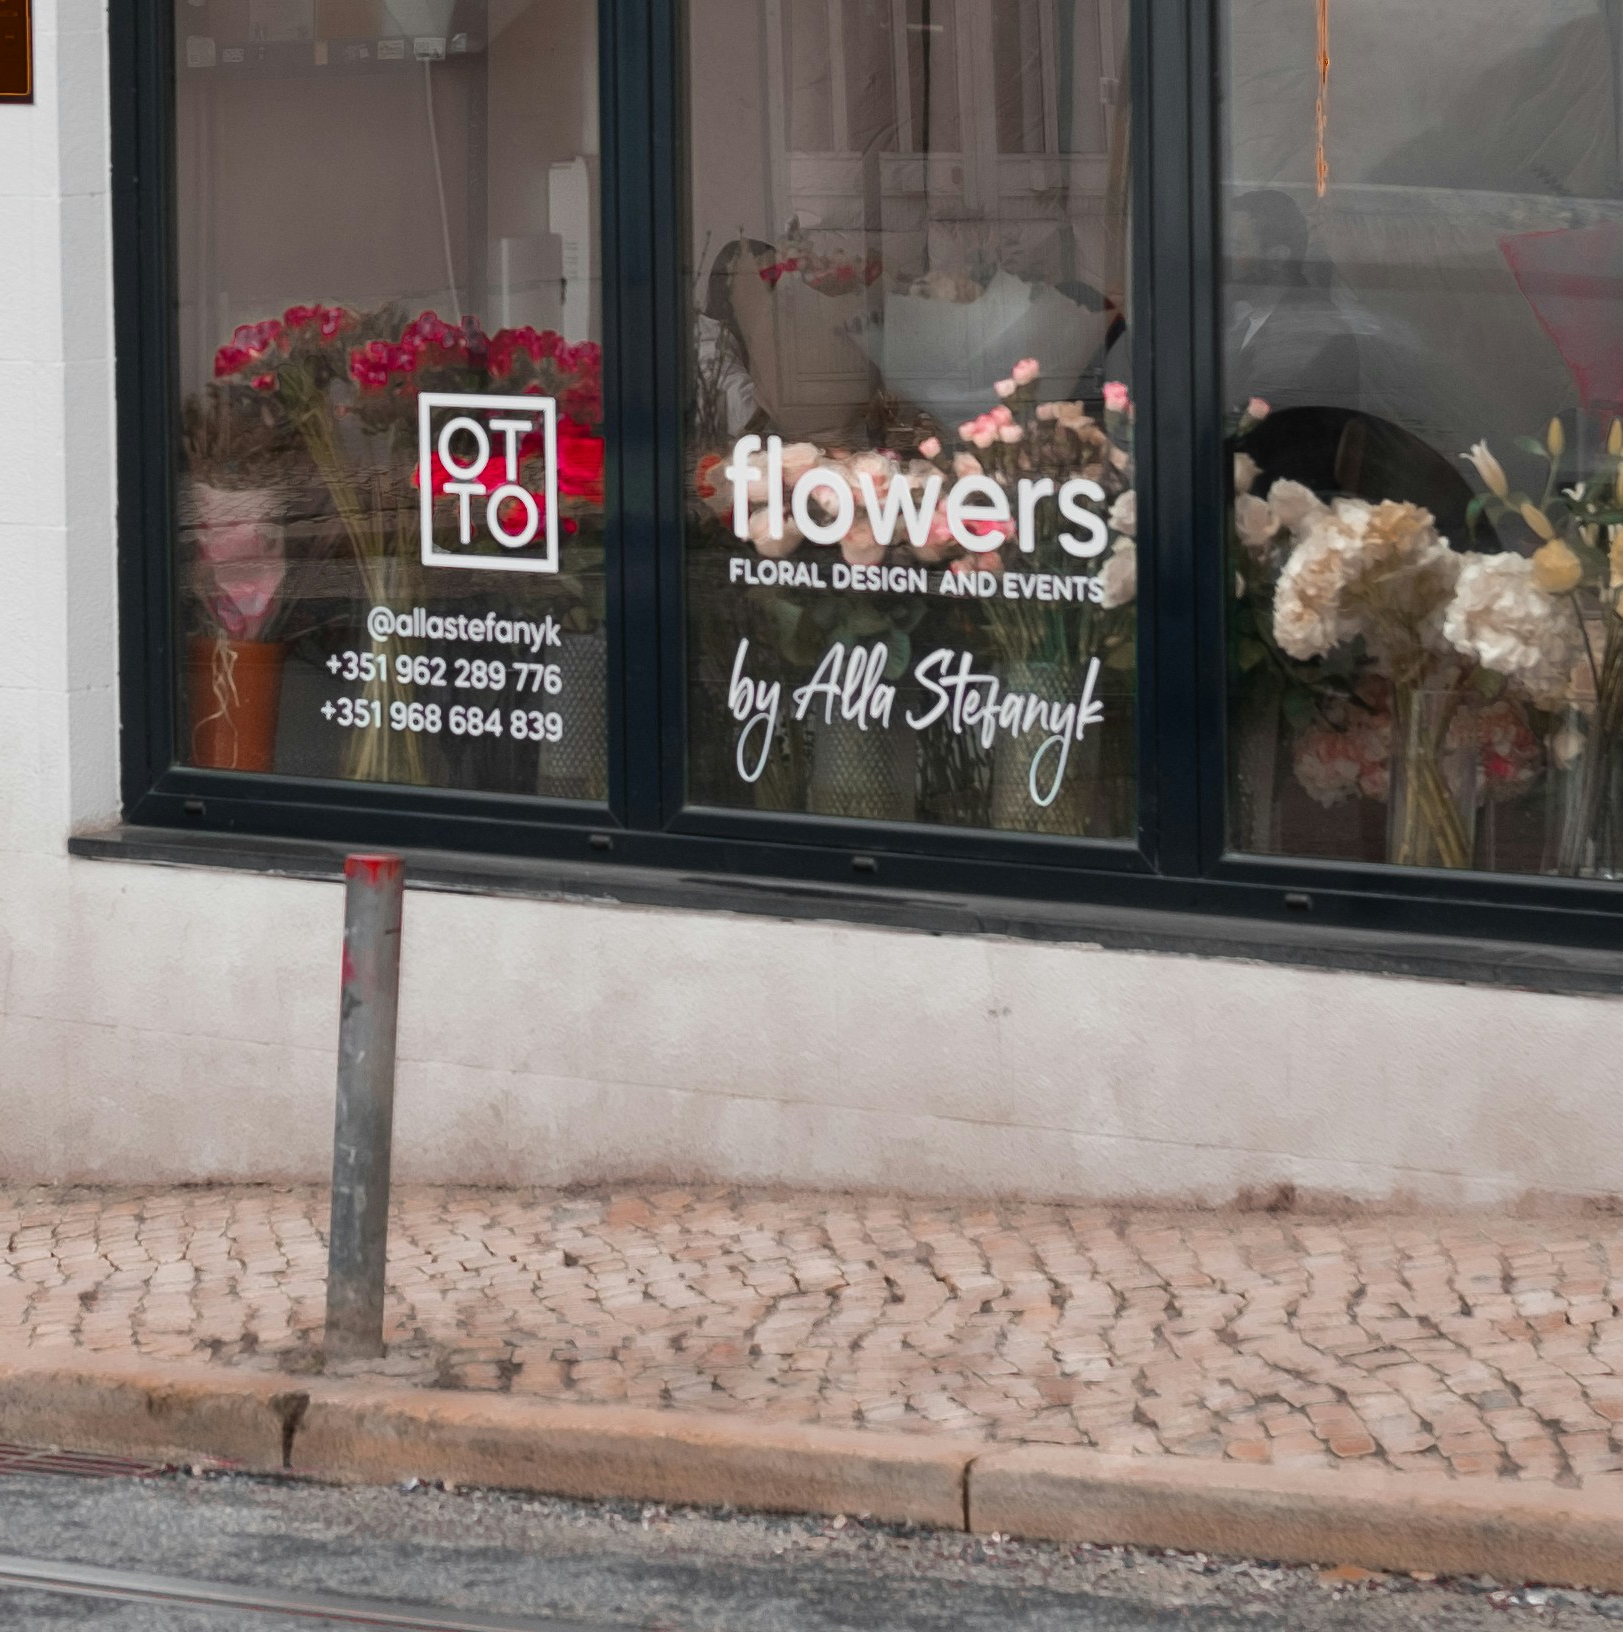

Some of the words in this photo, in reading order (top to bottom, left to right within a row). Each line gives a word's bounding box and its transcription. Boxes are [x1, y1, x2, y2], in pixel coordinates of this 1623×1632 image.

[725, 434, 1109, 558] flowers
[728, 557, 827, 589] FLORAL
[832, 565, 928, 594] DESIGN
[939, 570, 997, 598] AND
[1002, 572, 1105, 604] EVENTS
[367, 605, 562, 654] @allastefanyk
[325, 650, 387, 683] +351
[395, 654, 447, 686] 962
[454, 657, 506, 691] 289
[512, 661, 563, 695] 776
[320, 696, 382, 729] +351
[389, 700, 442, 734] 968
[448, 704, 503, 738] 684
[510, 709, 564, 743] 839
[727, 636, 781, 783] by
[792, 641, 896, 731] Alla
[905, 647, 1105, 807] Stefanyk
